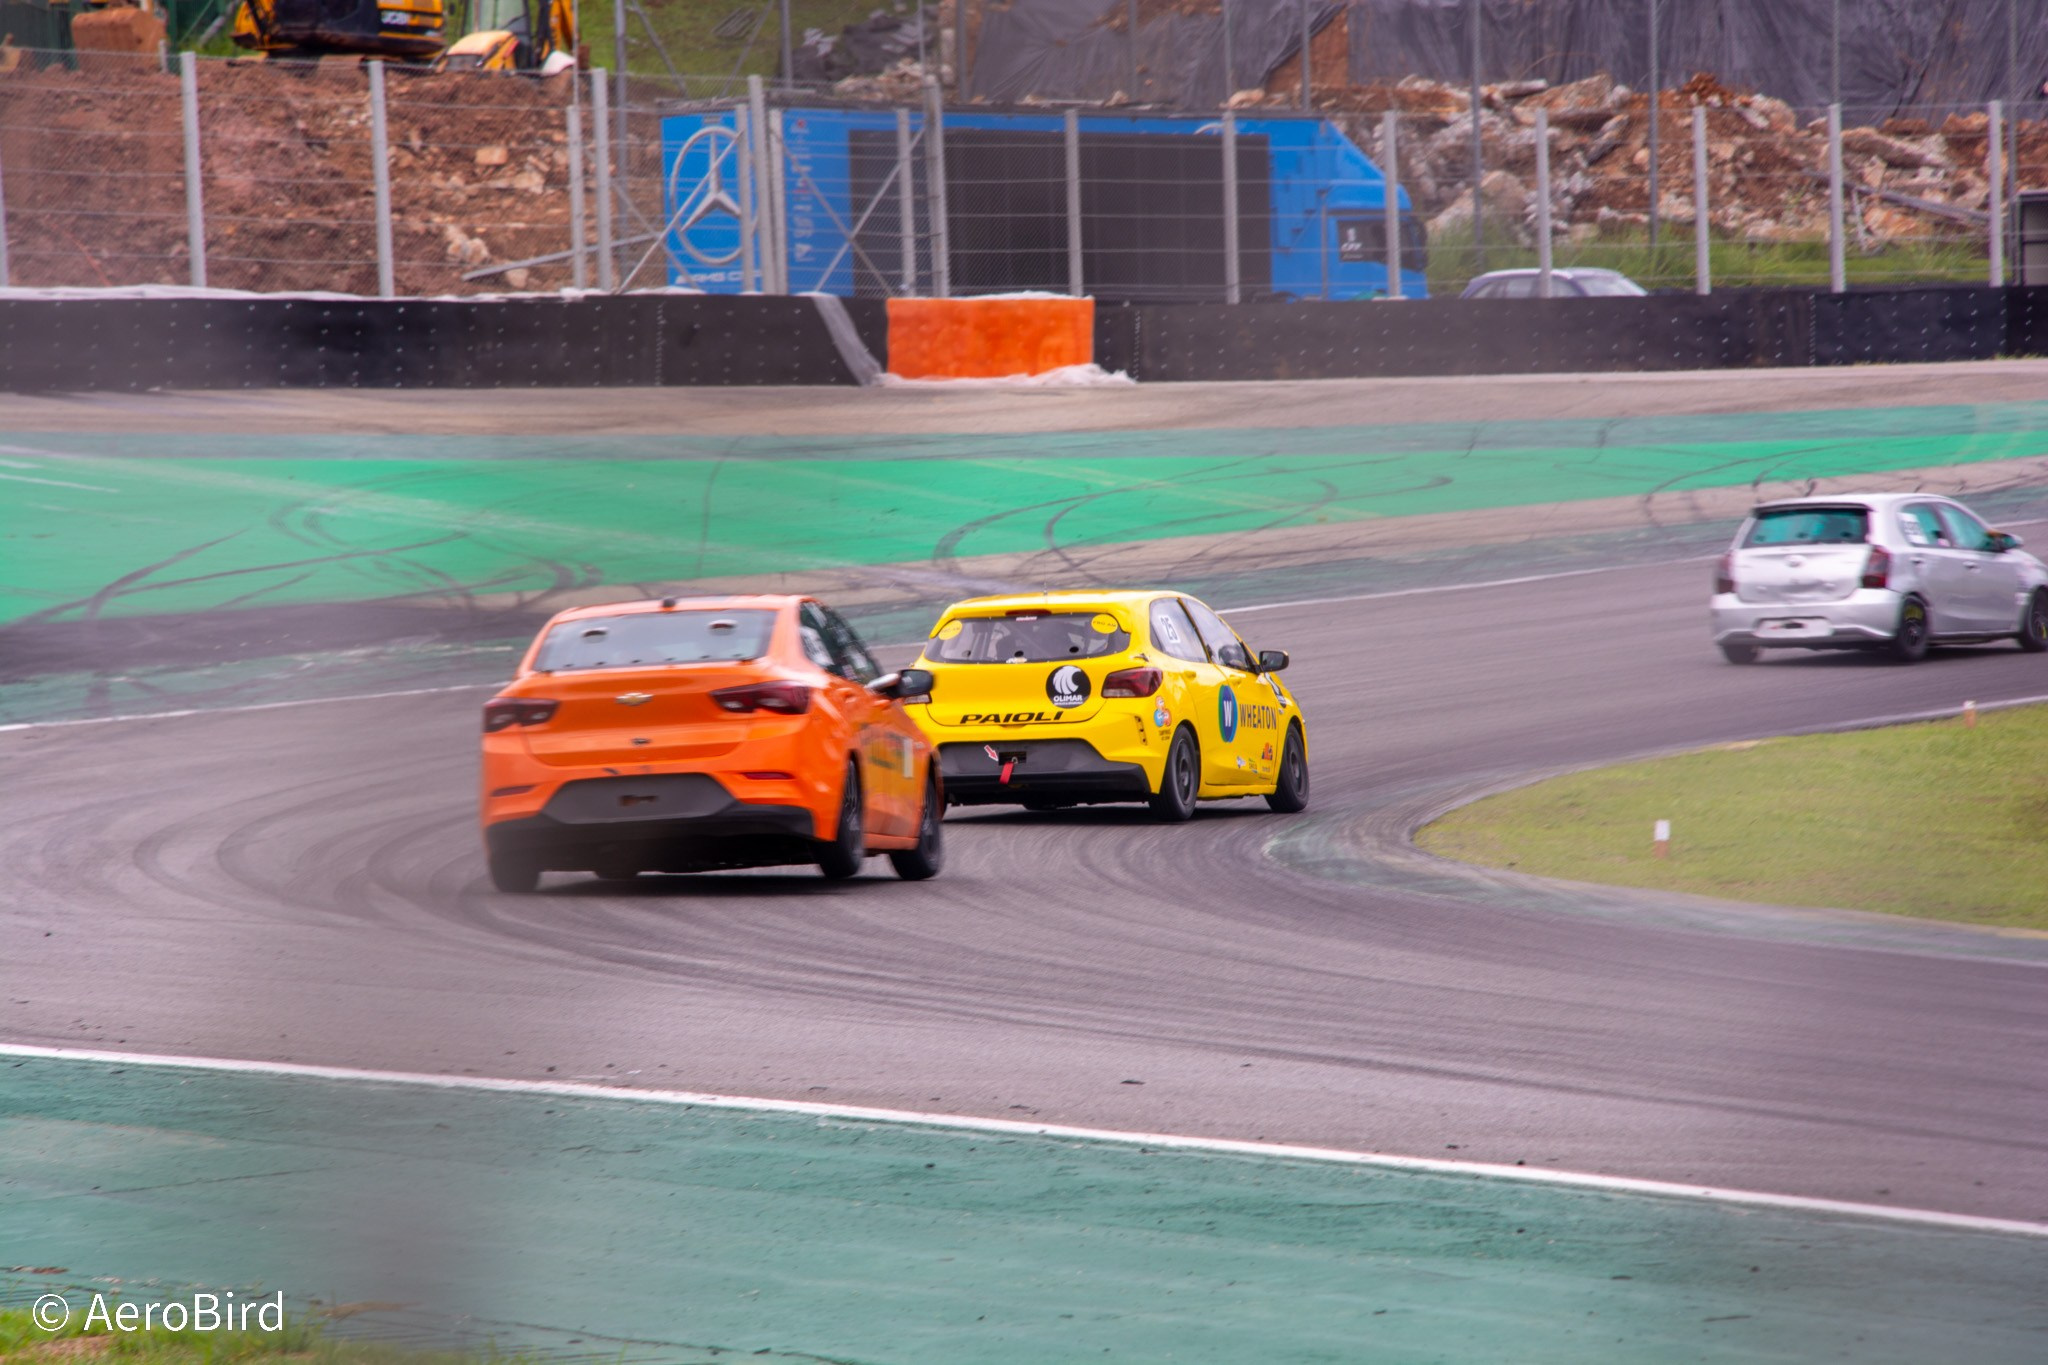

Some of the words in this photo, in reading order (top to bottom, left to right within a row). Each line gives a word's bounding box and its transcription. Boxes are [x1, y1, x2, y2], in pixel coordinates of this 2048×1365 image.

[1053, 694, 1083, 702] OLIMAR
[960, 711, 1064, 724] PAIOLI
[1223, 700, 1233, 727] W
[1239, 703, 1277, 730] WHEATON
